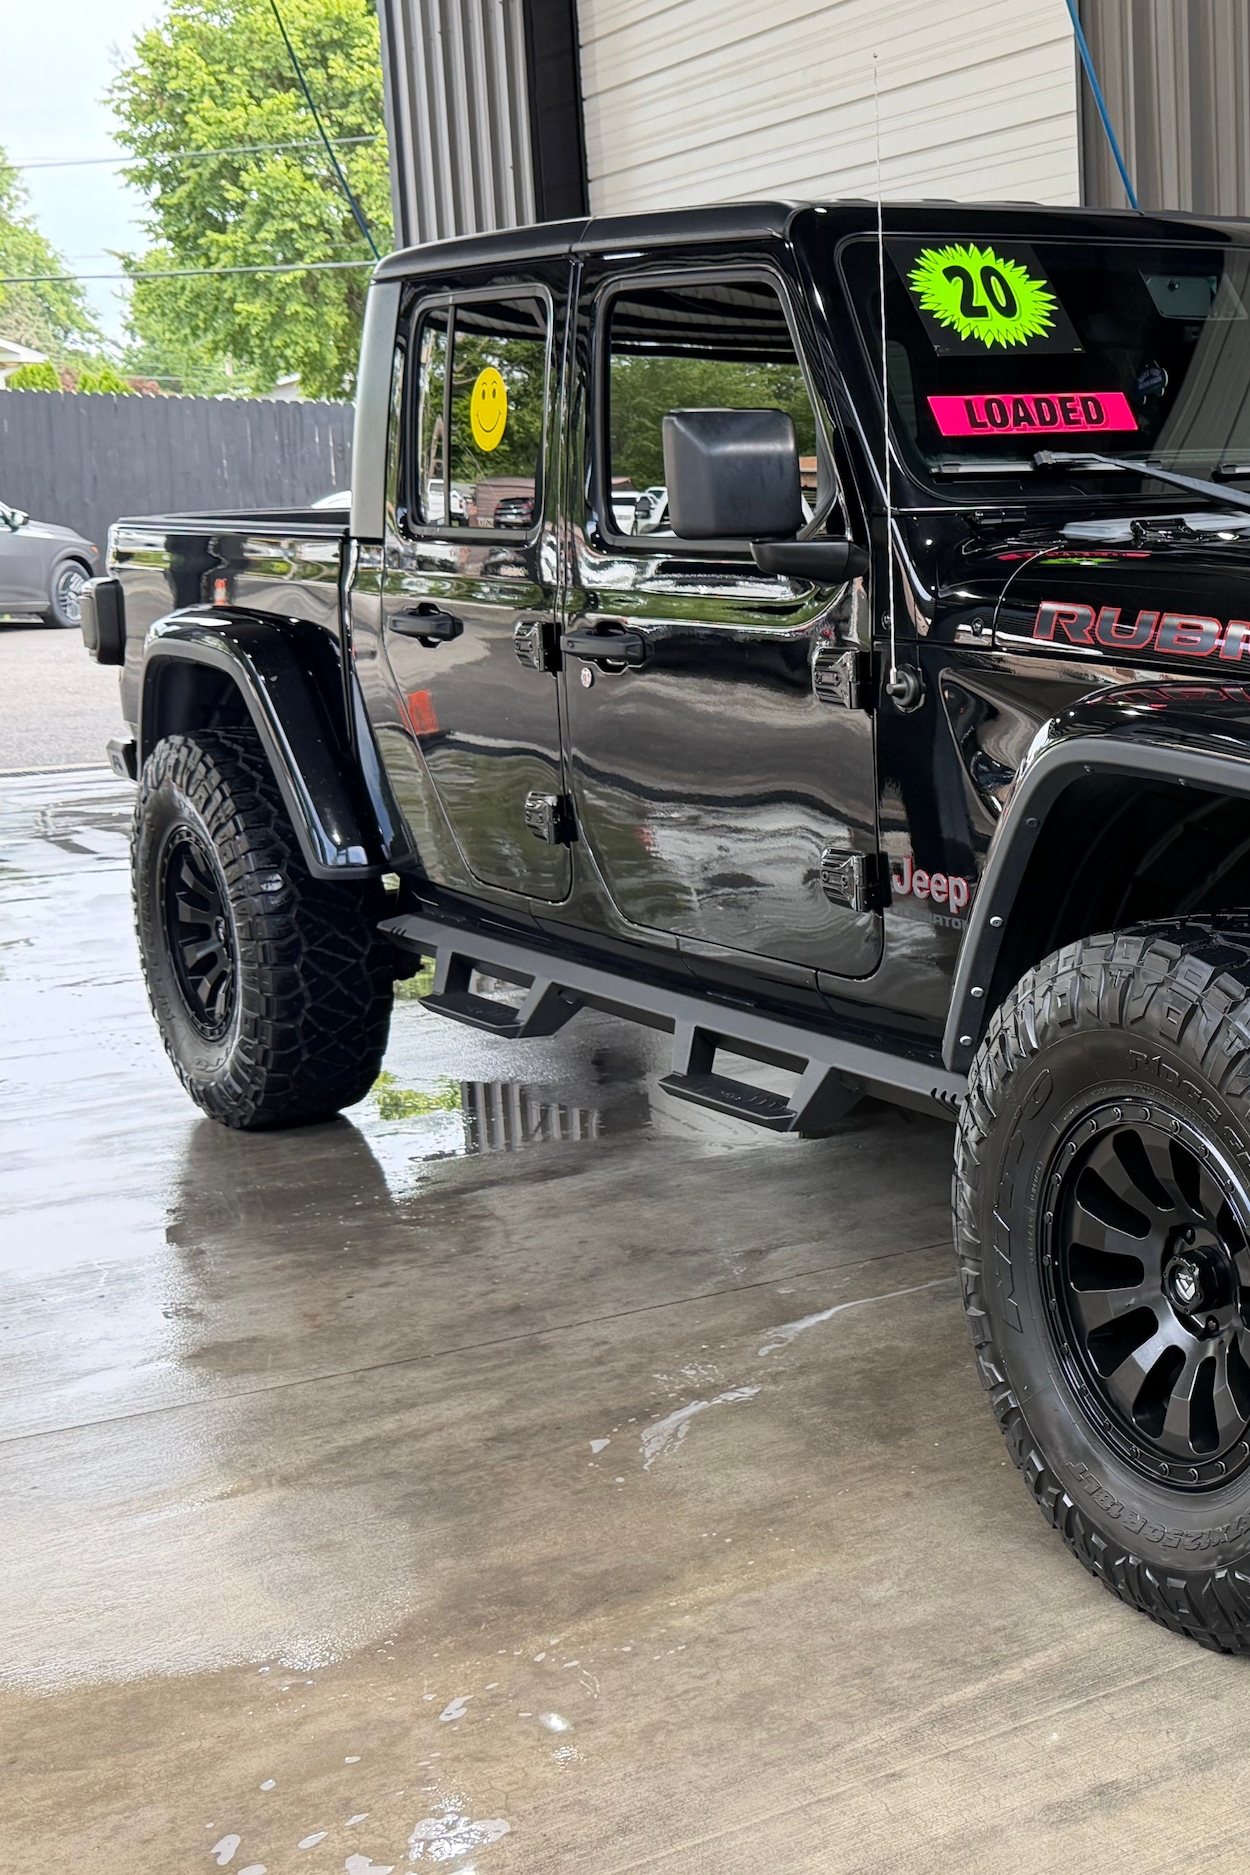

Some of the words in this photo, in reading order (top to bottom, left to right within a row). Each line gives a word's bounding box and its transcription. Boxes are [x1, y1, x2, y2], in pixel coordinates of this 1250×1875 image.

[942, 265, 1019, 319] 20
[964, 396, 1107, 430] LOADED
[892, 855, 970, 915] Jeep
